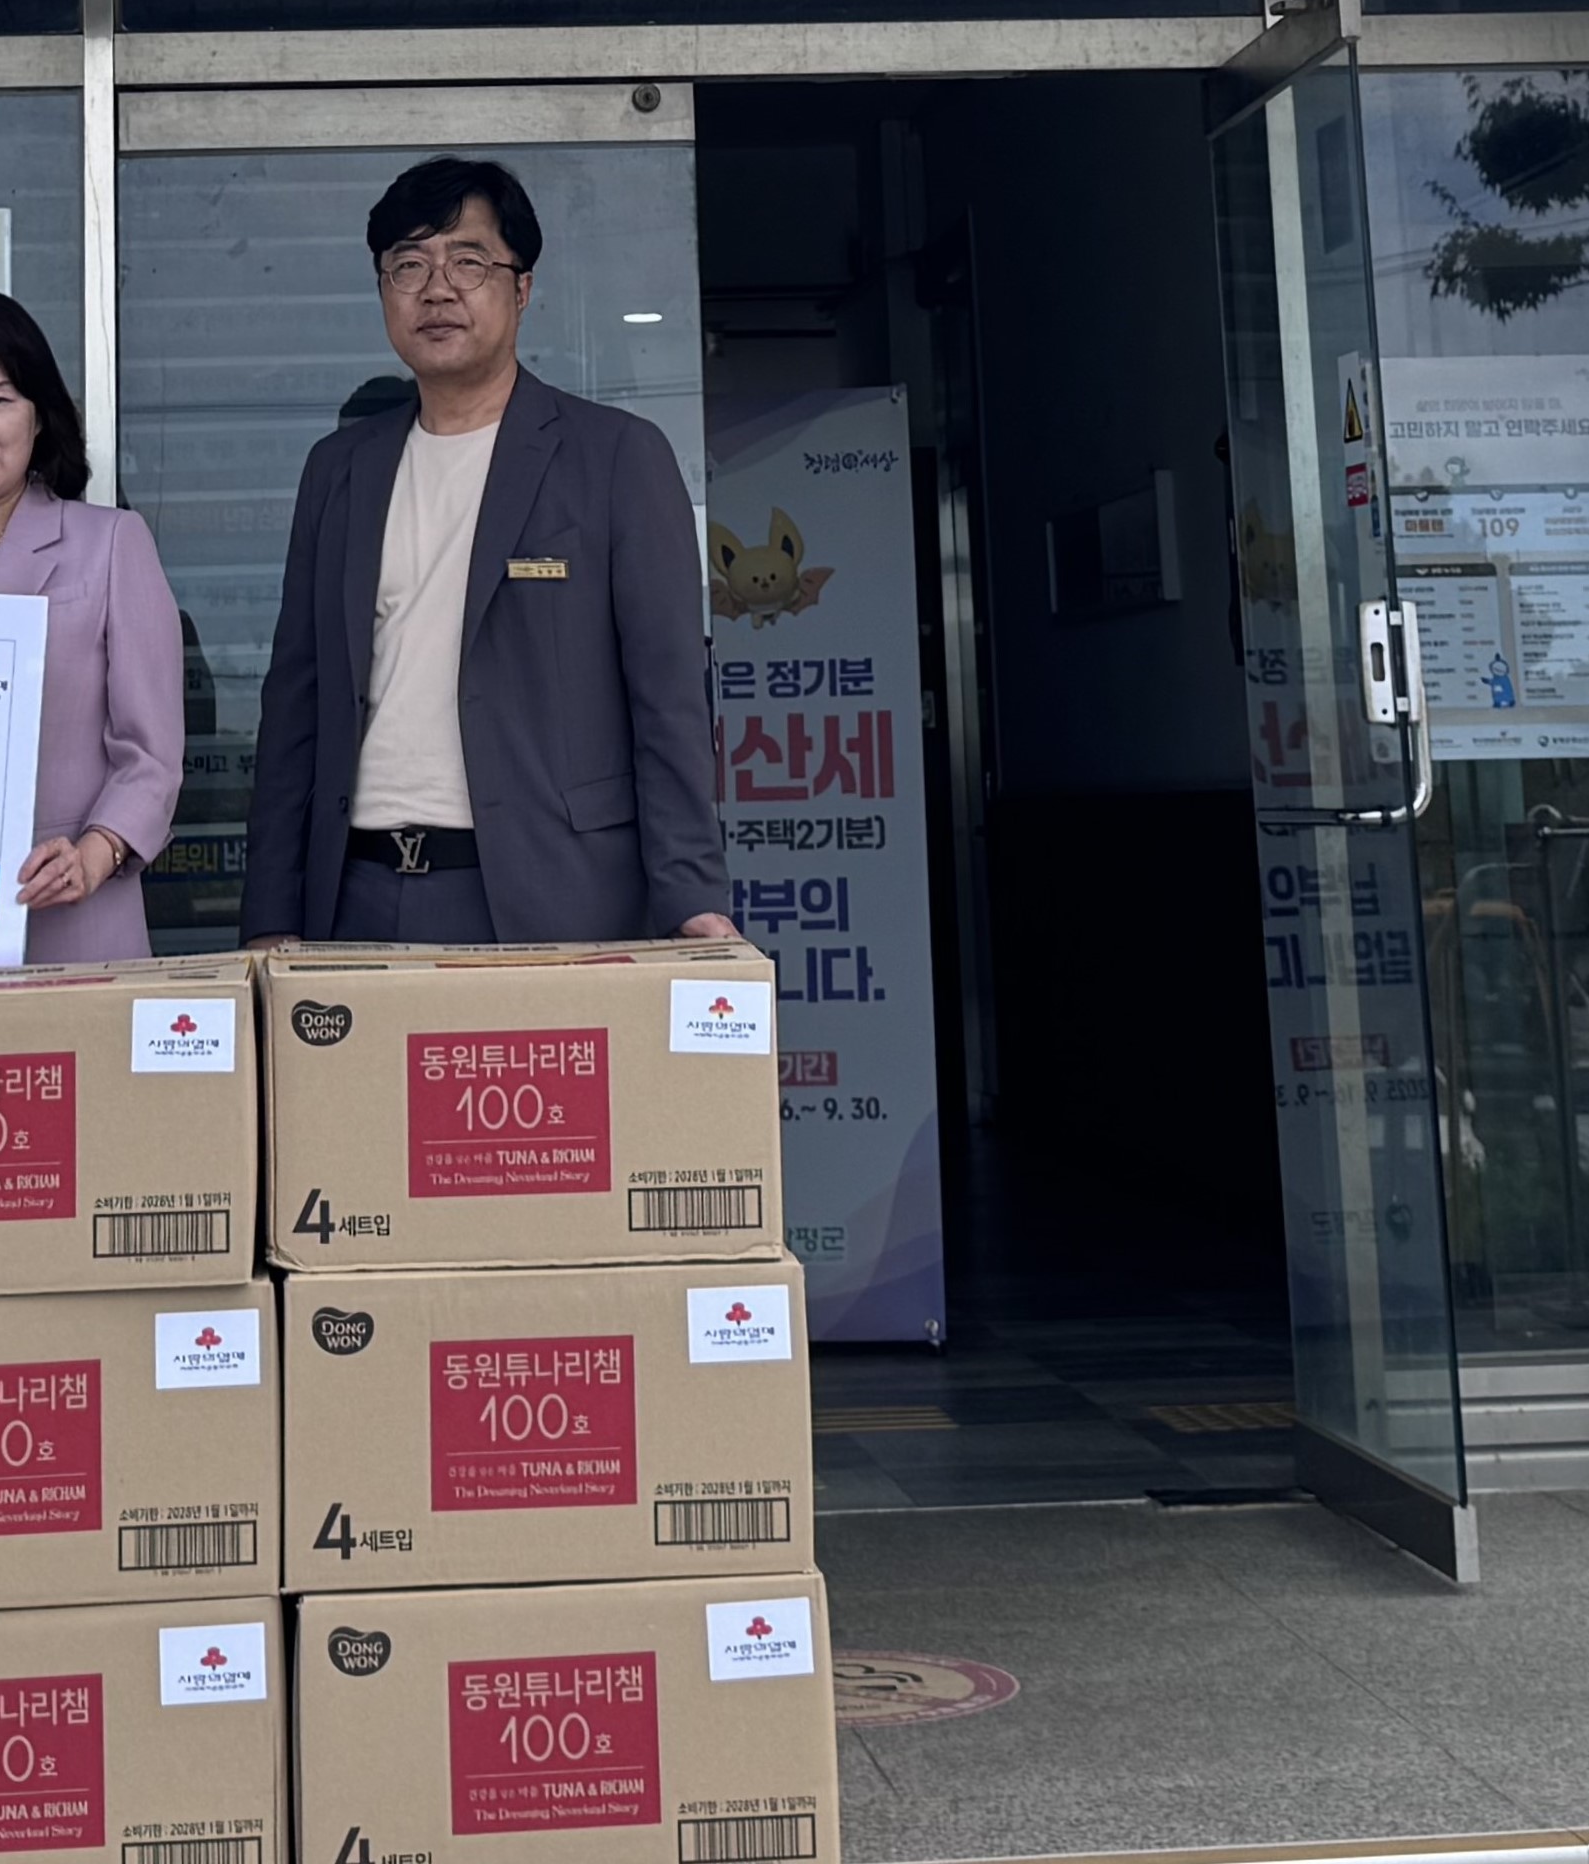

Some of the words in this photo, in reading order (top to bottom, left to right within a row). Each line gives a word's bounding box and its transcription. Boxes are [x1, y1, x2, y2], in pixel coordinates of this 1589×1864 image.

[1389, 420, 1460, 439] 고민하지
[1464, 419, 1501, 438] 말고
[1477, 516, 1521, 538] 109
[716, 658, 757, 700] 은
[766, 656, 875, 699] 정기분
[718, 708, 896, 804] 산세
[778, 945, 886, 1004] 니다.
[300, 1013, 345, 1029] DONG
[305, 1026, 340, 1041] WON
[420, 1042, 595, 1080] 동원튜나리챔
[780, 1052, 830, 1082] 기간
[455, 1085, 565, 1131] 100호
[823, 1097, 844, 1121] 9.
[850, 1096, 888, 1121] 30.
[497, 1149, 537, 1166] TUNA
[321, 1320, 367, 1336] DONG
[326, 1334, 362, 1348] WON
[442, 1349, 622, 1390] 동원튜나리챔
[479, 1394, 591, 1442] 100호
[521, 1460, 562, 1476] TUNA
[337, 1641, 384, 1657] DONG
[342, 1654, 379, 1669] WON
[461, 1667, 644, 1711] 동원튜나리챔
[500, 1713, 614, 1764] 100호
[543, 1783, 586, 1799] TUNA
